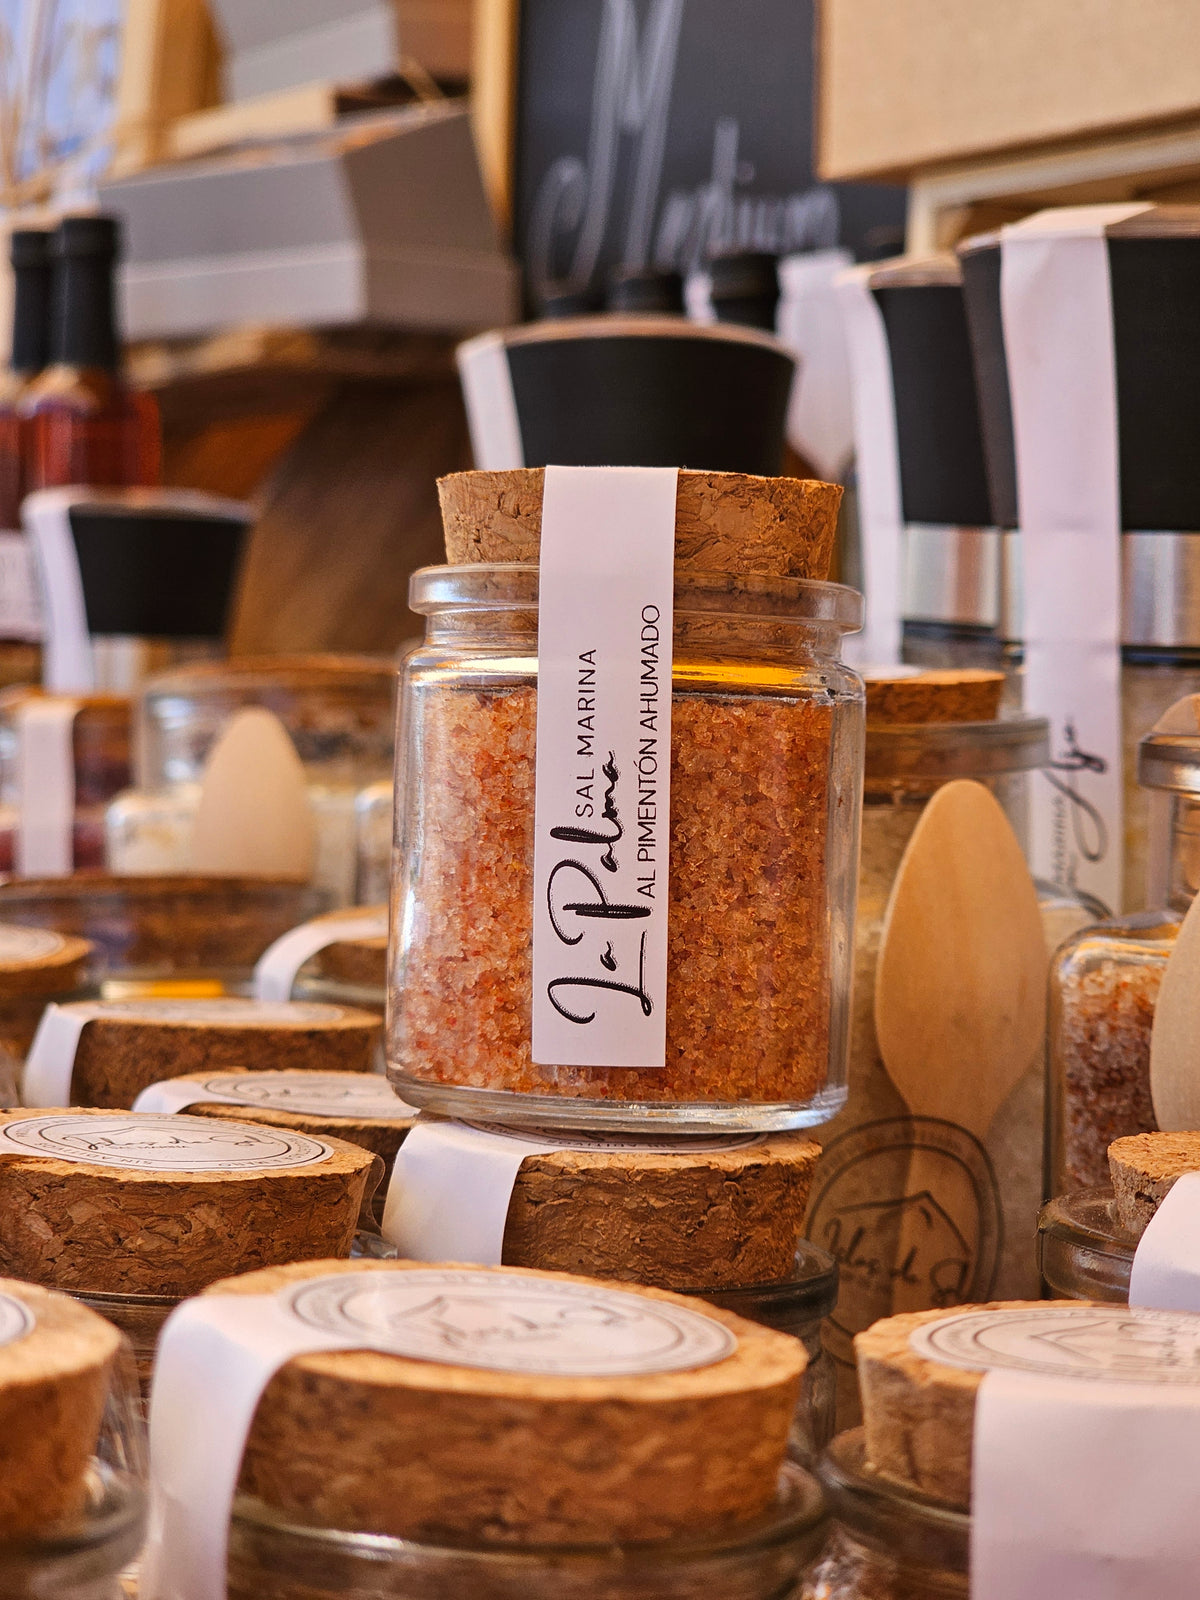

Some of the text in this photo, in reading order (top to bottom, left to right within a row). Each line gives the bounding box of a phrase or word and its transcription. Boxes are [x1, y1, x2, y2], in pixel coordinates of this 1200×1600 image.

[575, 648, 597, 818] SAL MARINA
[633, 604, 661, 898] AL PIMENTÓN AHUMADO
[546, 750, 654, 1025] La Palma
